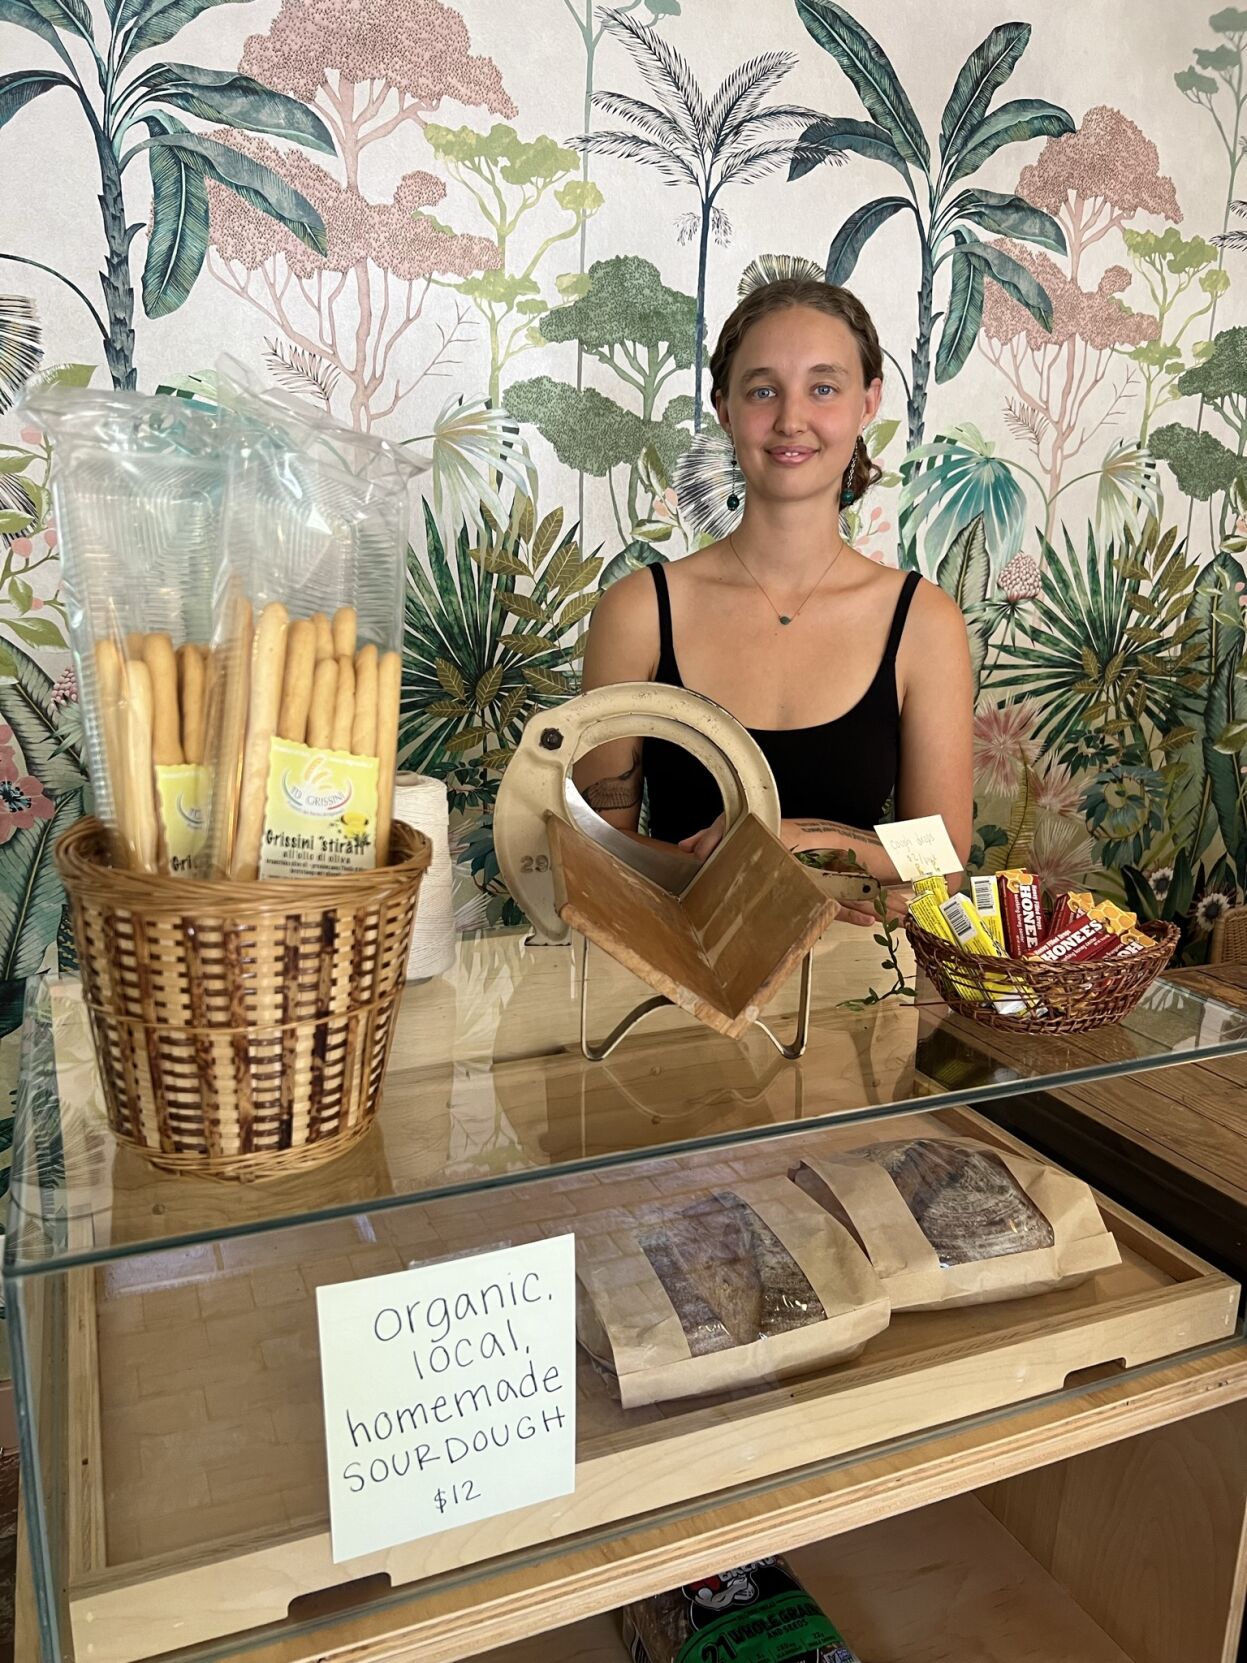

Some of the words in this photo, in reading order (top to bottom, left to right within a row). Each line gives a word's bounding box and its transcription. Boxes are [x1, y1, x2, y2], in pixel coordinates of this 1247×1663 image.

[266, 829, 314, 850] Grissini
[1020, 885, 1038, 949] HONEE
[1041, 920, 1103, 961] HONEES
[346, 1360, 563, 1447] homemade
[343, 1406, 566, 1492] SOURDOUGH
[433, 1480, 482, 1513] $12
[701, 1632, 738, 1663] 21
[726, 1613, 779, 1644] WHOLE
[768, 1627, 783, 1639] AND
[783, 1618, 808, 1632] SEEDS
